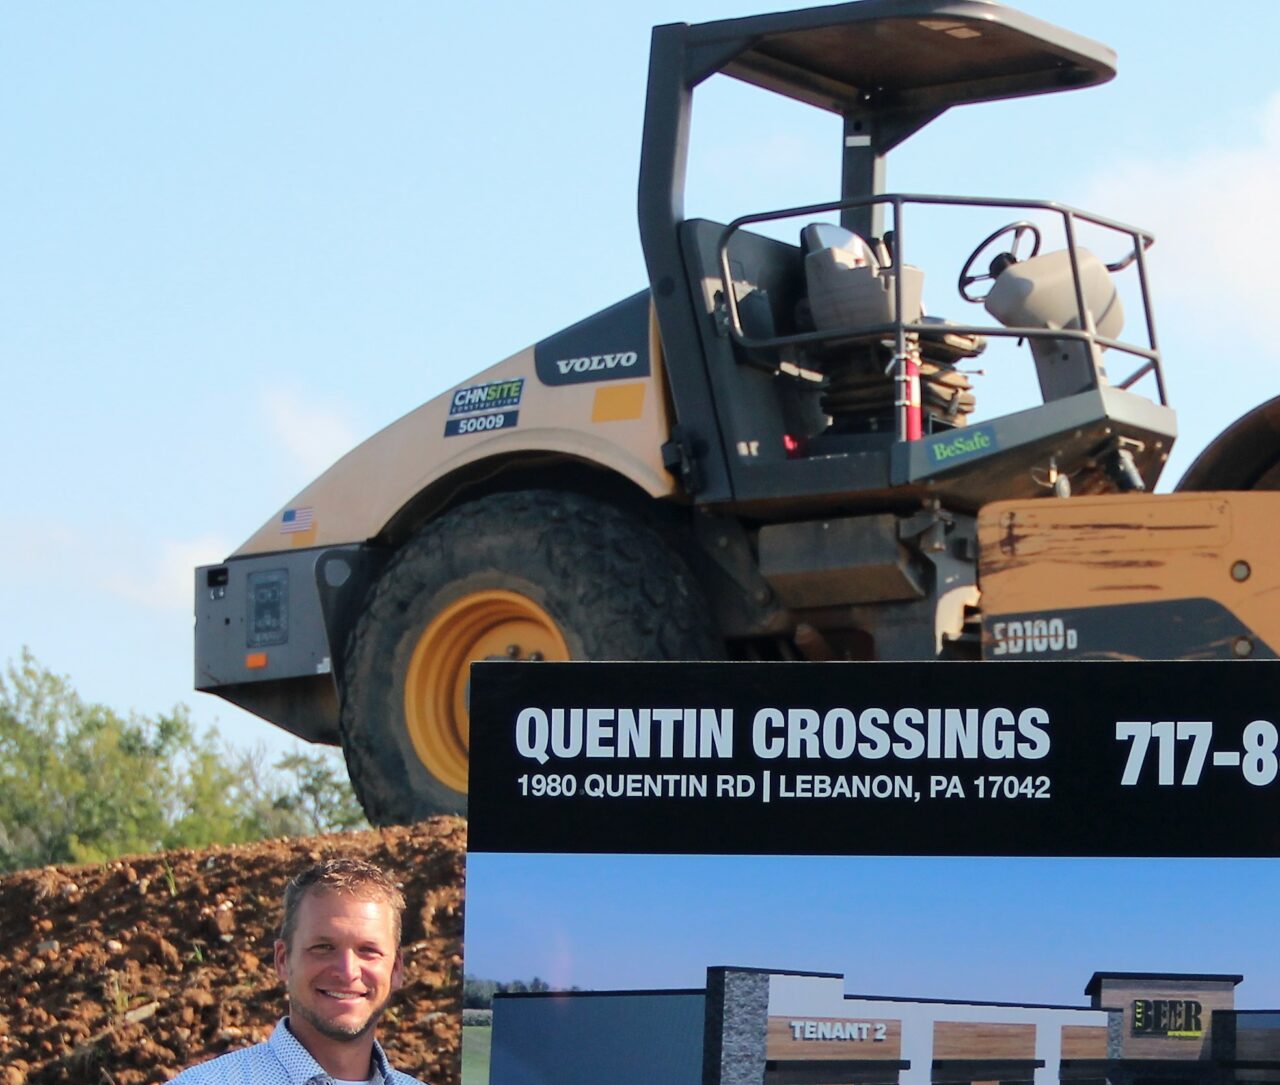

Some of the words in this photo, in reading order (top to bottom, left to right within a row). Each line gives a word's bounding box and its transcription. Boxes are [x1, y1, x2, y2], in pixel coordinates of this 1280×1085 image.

[557, 351, 638, 374] VOLVO
[454, 381, 521, 406] CHNSITE
[458, 414, 504, 434] 50009
[933, 432, 990, 460] BeSafe
[515, 707, 733, 765] QUENTIN
[752, 707, 1051, 759] CROSSINGS
[517, 774, 577, 797] 1980
[584, 774, 708, 798] QUENTIN
[716, 774, 755, 797] RD
[779, 774, 921, 801] LEBANON,
[930, 775, 965, 798] PA
[973, 775, 1051, 798] 17042
[789, 1020, 873, 1041] TENANT
[873, 1022, 887, 1041] 2
